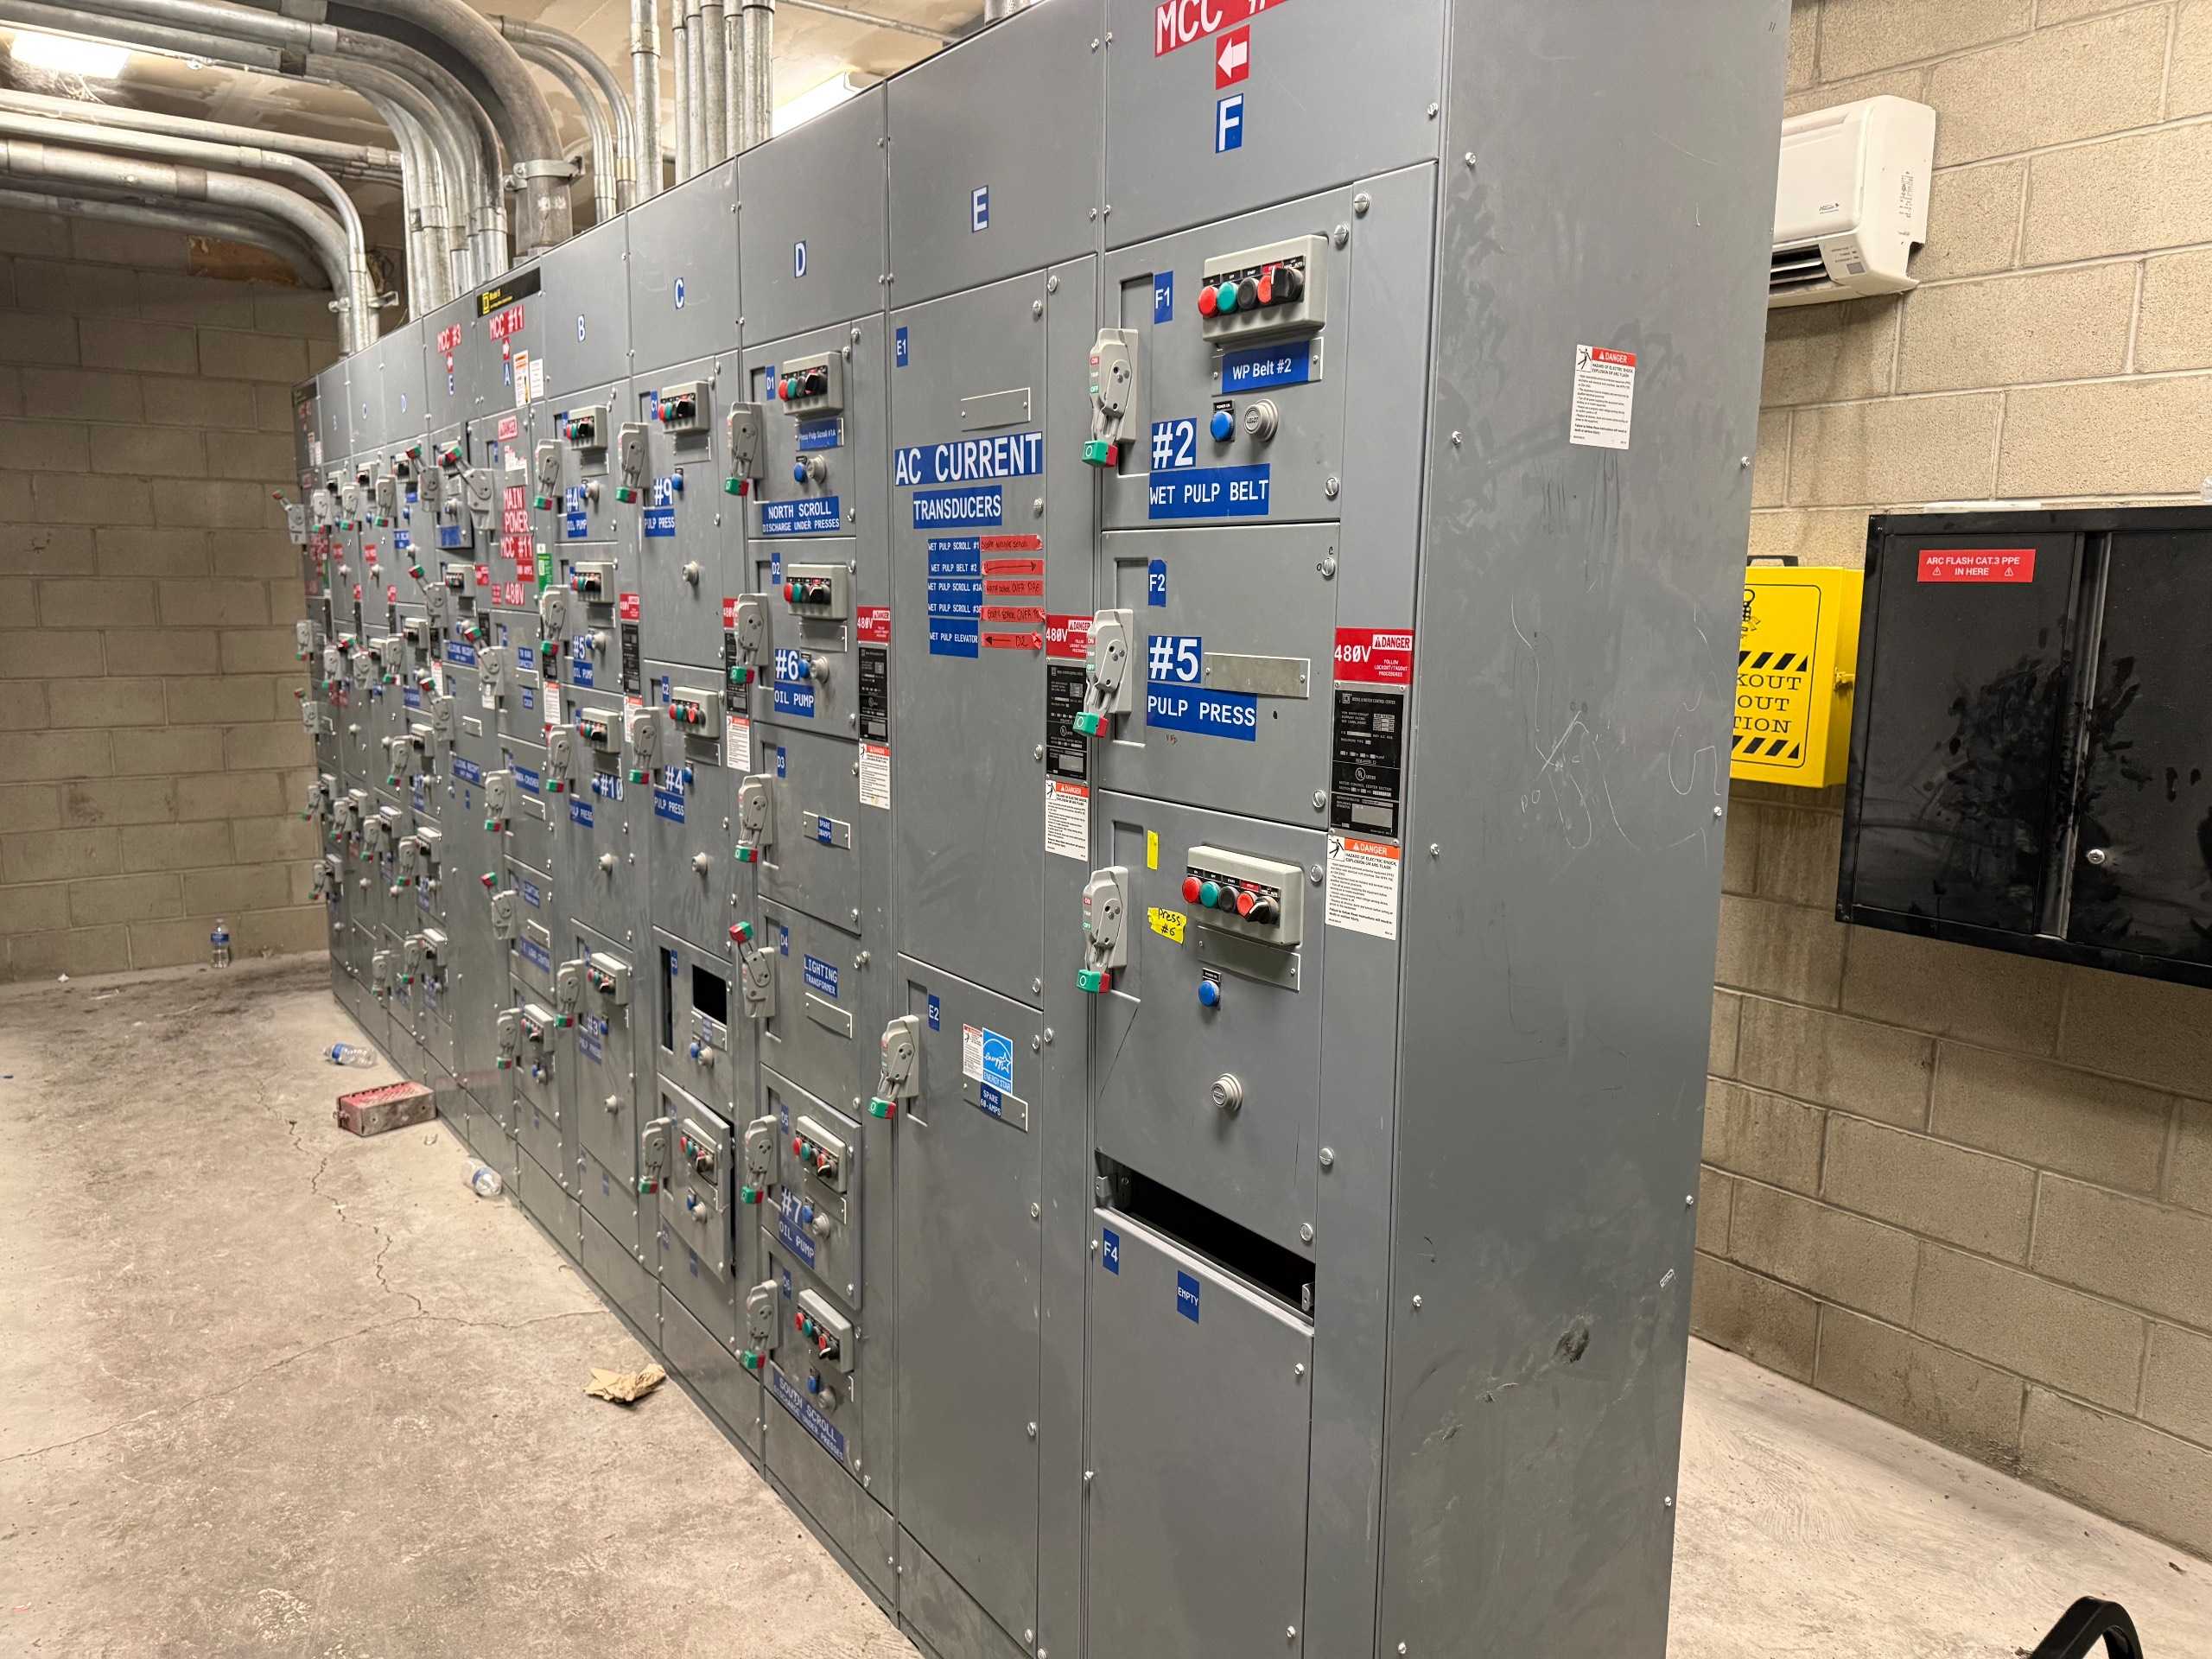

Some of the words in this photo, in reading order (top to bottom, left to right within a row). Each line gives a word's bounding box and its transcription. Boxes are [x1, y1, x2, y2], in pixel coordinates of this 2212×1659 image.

[1156, 0, 1224, 54] MCC
[1219, 96, 1243, 151] F
[974, 187, 988, 232] E
[796, 243, 805, 277] D
[676, 279, 684, 308] C
[1155, 287, 1170, 309] F1
[490, 315, 505, 340] MCC
[508, 306, 524, 333] #11
[578, 315, 585, 341] B
[897, 340, 906, 356] E1
[1605, 353, 1627, 363] DANGER
[505, 364, 511, 386] A
[1232, 366, 1249, 380] WP
[1253, 361, 1274, 378] Belt
[1277, 358, 1292, 373] #2
[767, 379, 774, 390] D1
[1153, 421, 1193, 469] #2
[896, 448, 921, 486] AC
[935, 433, 1042, 482] CURRENT
[505, 487, 523, 509] MAIN
[567, 487, 578, 512] #4
[654, 479, 673, 506] #9
[1150, 486, 1176, 505] WET
[1185, 484, 1220, 503] PULP
[1230, 480, 1268, 501] BELT
[768, 505, 794, 519] NORTH
[799, 501, 831, 517] SCROLL
[913, 495, 1001, 520] TRANSDUCERS
[505, 512, 529, 533] POWER
[658, 518, 675, 529] PRESS
[763, 522, 791, 532] DISCHARGE
[794, 520, 811, 531] UNDER
[815, 518, 840, 529] PRESSES
[939, 542, 950, 550] PULP
[953, 542, 970, 550] SCROLL
[772, 563, 780, 575] D2
[953, 583, 970, 592] SCROLL
[1149, 574, 1166, 592] F2
[941, 633, 952, 642] PULP
[955, 633, 978, 644] ELEVATOR
[1046, 628, 1068, 642] 480V
[1382, 637, 1410, 649] DANGER
[574, 636, 585, 659] #5
[1334, 645, 1371, 663] 480V
[776, 649, 798, 680] #6
[1149, 637, 1199, 682] #5
[1737, 673, 1802, 690] KOUT
[775, 690, 789, 704] OIL
[794, 692, 815, 708] PUMP
[1738, 696, 1789, 712] OUT
[1148, 696, 1188, 717] PULP
[1200, 702, 1255, 727] PRESS
[1733, 716, 1793, 734] TION
[601, 774, 623, 802] #10
[665, 766, 684, 794] #4
[669, 801, 684, 816] PRESS
[1360, 842, 1388, 855] DANGER
[1161, 925, 1176, 937] #6
[804, 957, 837, 983] LIGHTING
[805, 974, 836, 995] TRANSFORMER
[929, 1005, 939, 1021] E2
[1000, 1080, 1011, 1090] STAR
[983, 1089, 999, 1104] SPARE
[782, 1188, 802, 1224] #7
[779, 1221, 792, 1242] OIL
[796, 1232, 815, 1258] PUMP
[1104, 1242, 1118, 1262] F4
[1178, 1287, 1199, 1306] EMPTY
[807, 1405, 837, 1442] SCROLL
